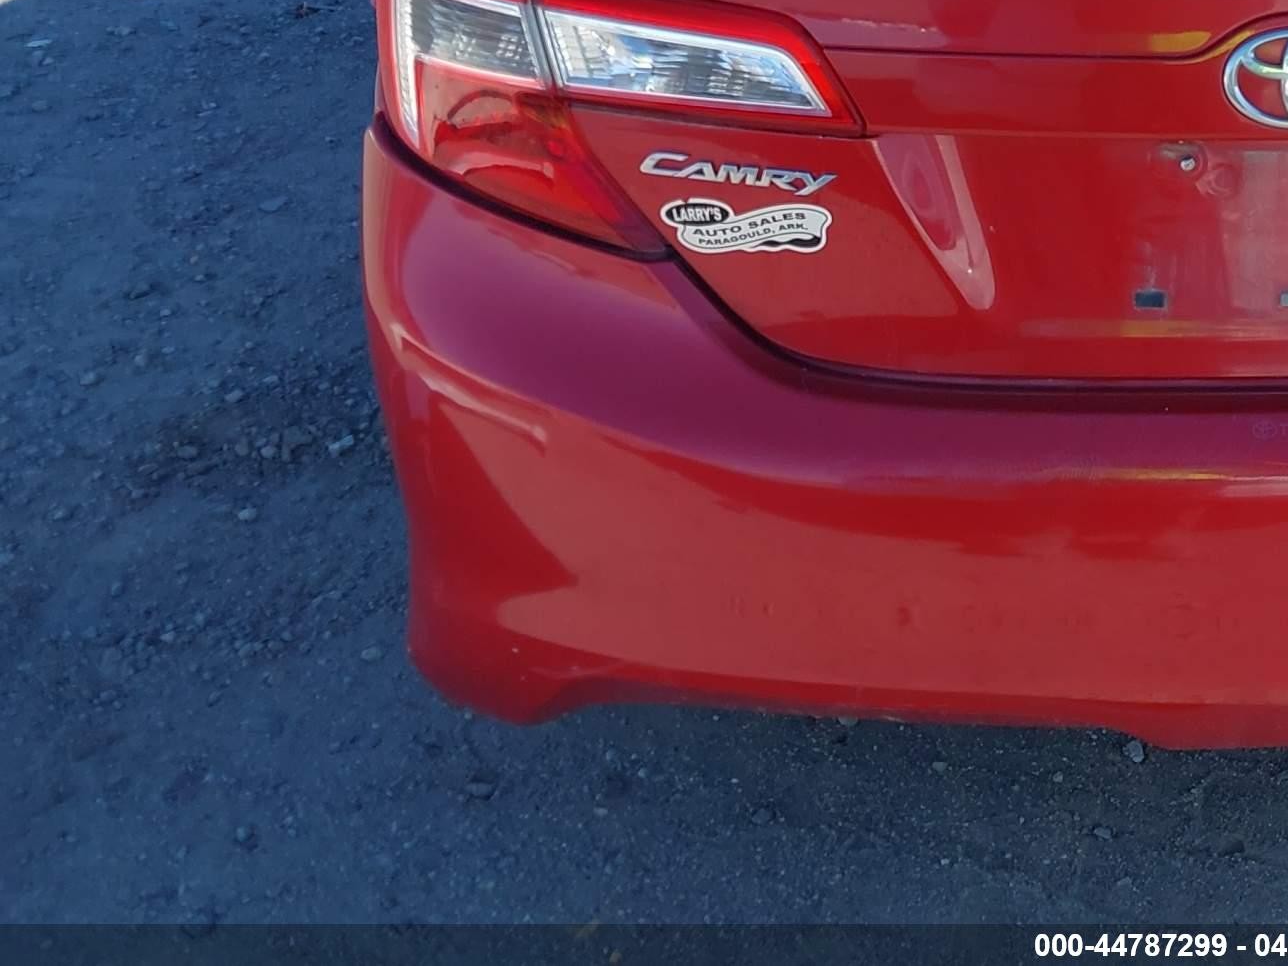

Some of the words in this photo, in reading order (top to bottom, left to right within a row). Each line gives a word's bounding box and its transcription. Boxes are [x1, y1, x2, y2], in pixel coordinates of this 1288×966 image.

[640, 151, 837, 196] CAMRY
[671, 206, 722, 222] LARRY'S
[692, 225, 742, 237] AUTO
[748, 212, 806, 230] SALES
[698, 227, 776, 246] PARAGOULD,
[779, 223, 809, 231] ARK.
